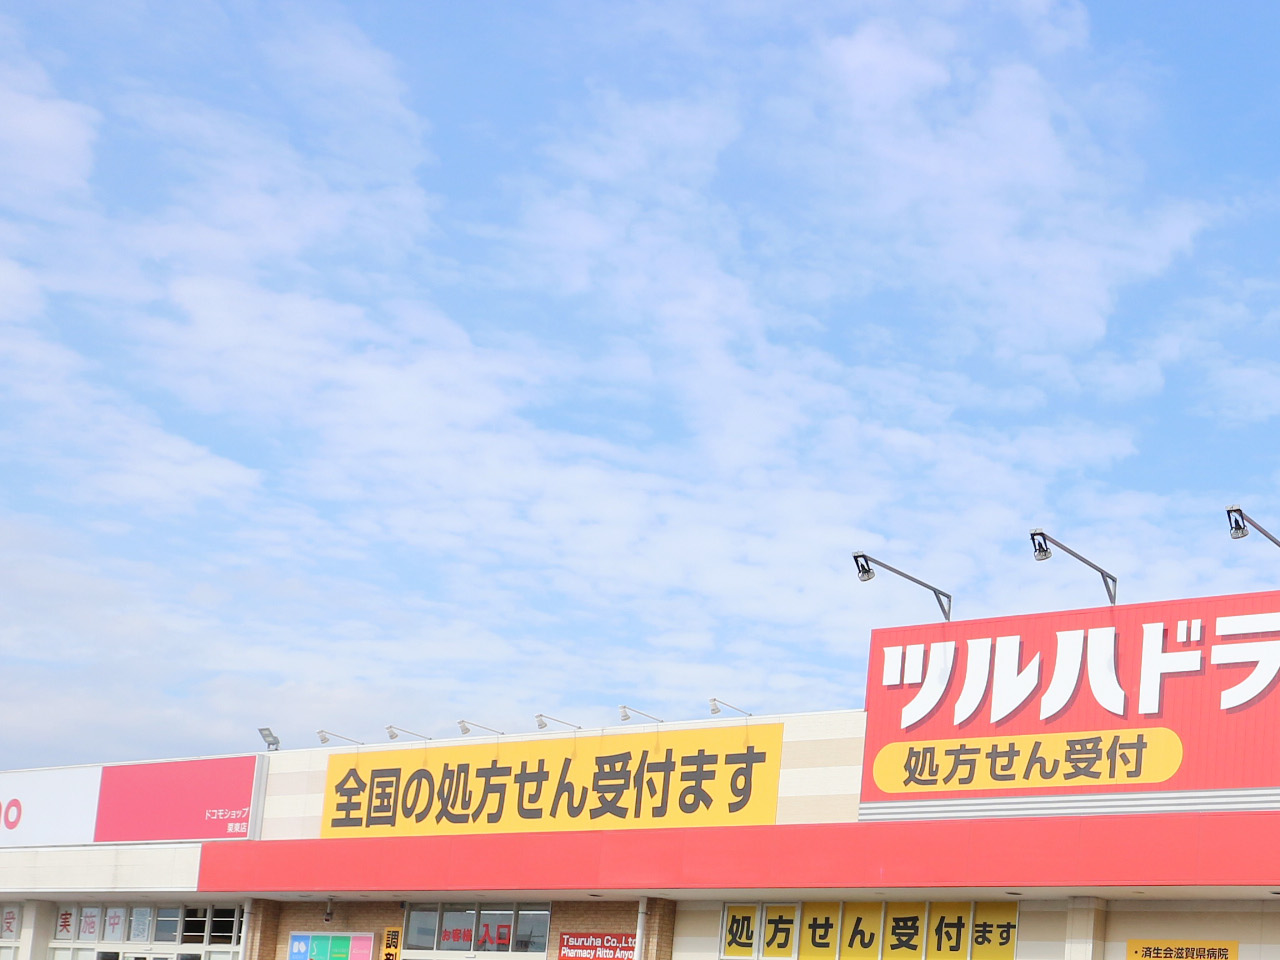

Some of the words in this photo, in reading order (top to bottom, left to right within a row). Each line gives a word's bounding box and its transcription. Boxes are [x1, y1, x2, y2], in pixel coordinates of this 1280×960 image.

[902, 732, 1149, 787] 処方せん受付
[330, 745, 767, 828] 全国の処方せん受付ます
[0, 798, 22, 830] o
[205, 807, 250, 820] ドコモショップ
[59, 910, 121, 935] 実施中
[441, 928, 473, 942] お客様
[477, 923, 512, 945] 入口
[727, 914, 1017, 952] 処方せん受付ます
[562, 935, 602, 946] Tsuruha
[561, 947, 595, 959] Pharmacy
[596, 947, 614, 959] Ritto
[1141, 946, 1229, 960] 済生会滋賀県病院
